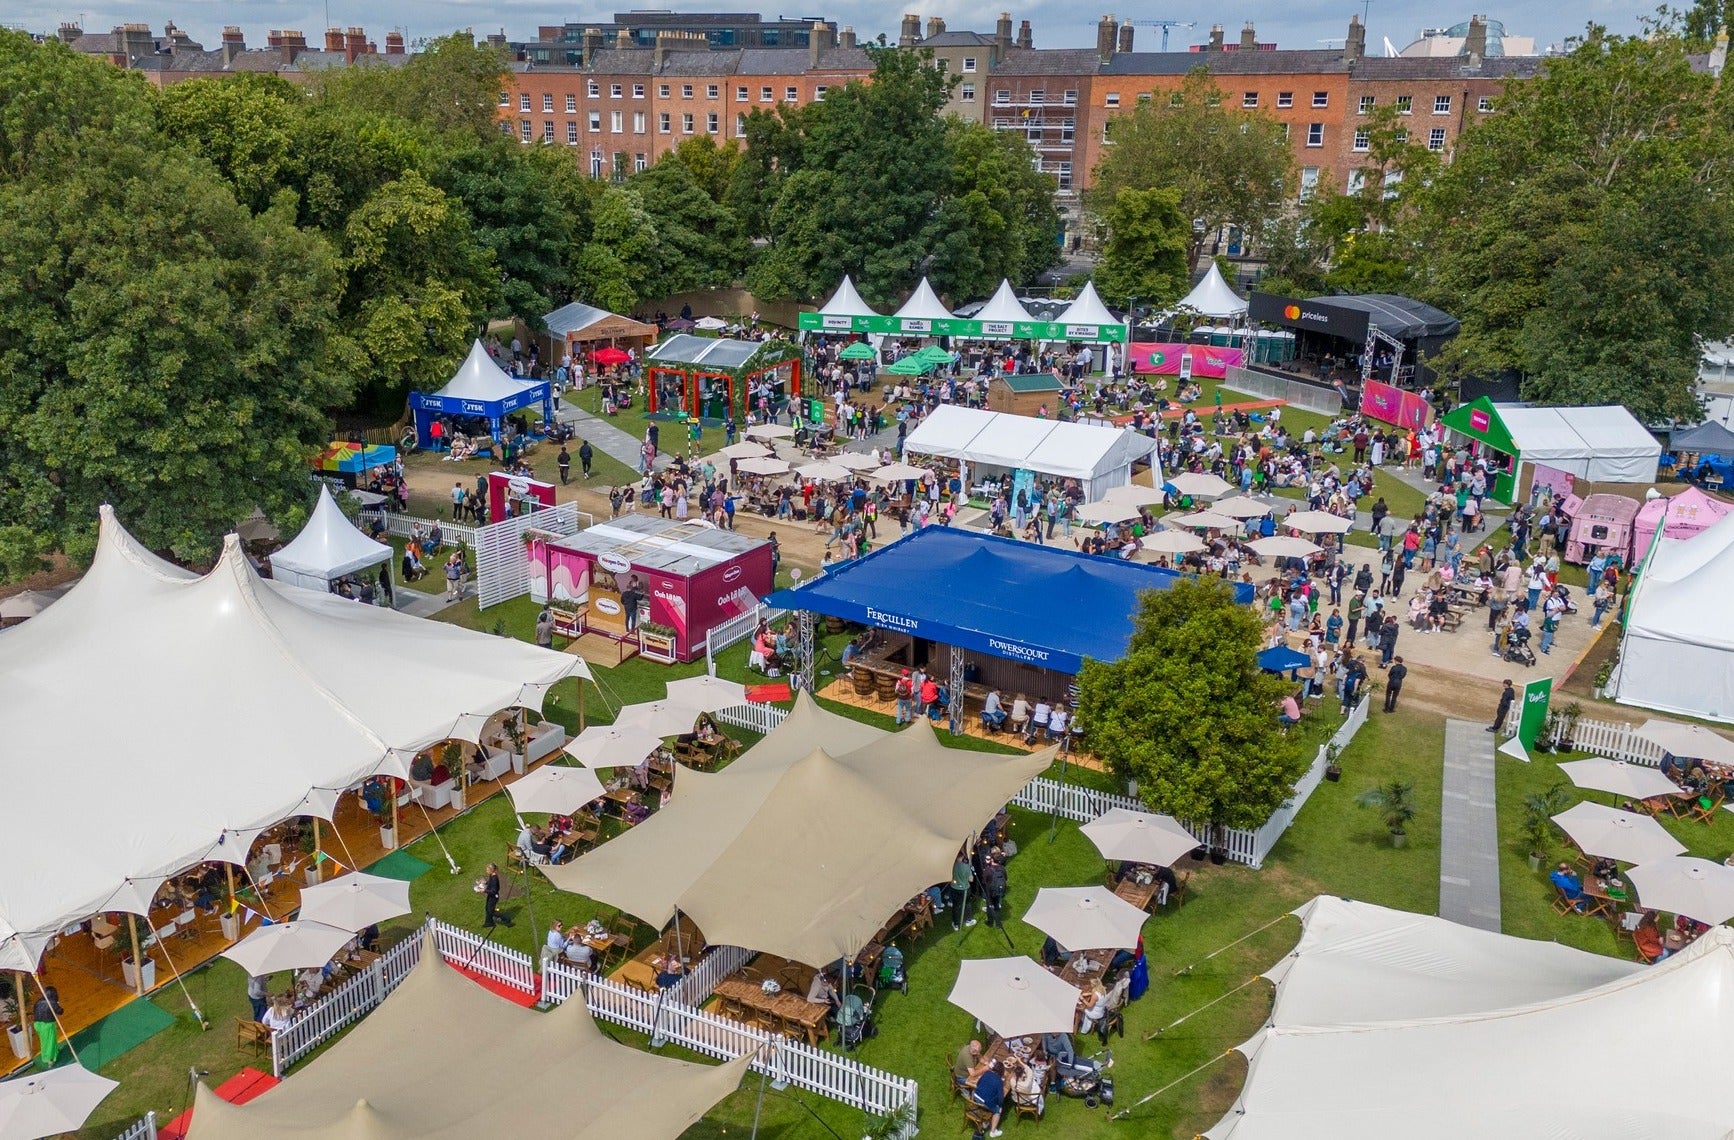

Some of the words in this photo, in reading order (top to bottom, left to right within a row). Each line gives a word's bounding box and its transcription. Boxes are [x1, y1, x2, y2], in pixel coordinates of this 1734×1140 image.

[1301, 312, 1328, 322] priceless
[532, 389, 543, 399] JYSK
[425, 399, 441, 408] JYSK
[467, 403, 483, 412] JYSK
[506, 399, 517, 409] JYSK
[654, 590, 666, 599] Ooh
[718, 594, 730, 606] Ooh
[989, 639, 1049, 661] POWERSCOURT
[1002, 650, 1035, 661] DISTILLERY
